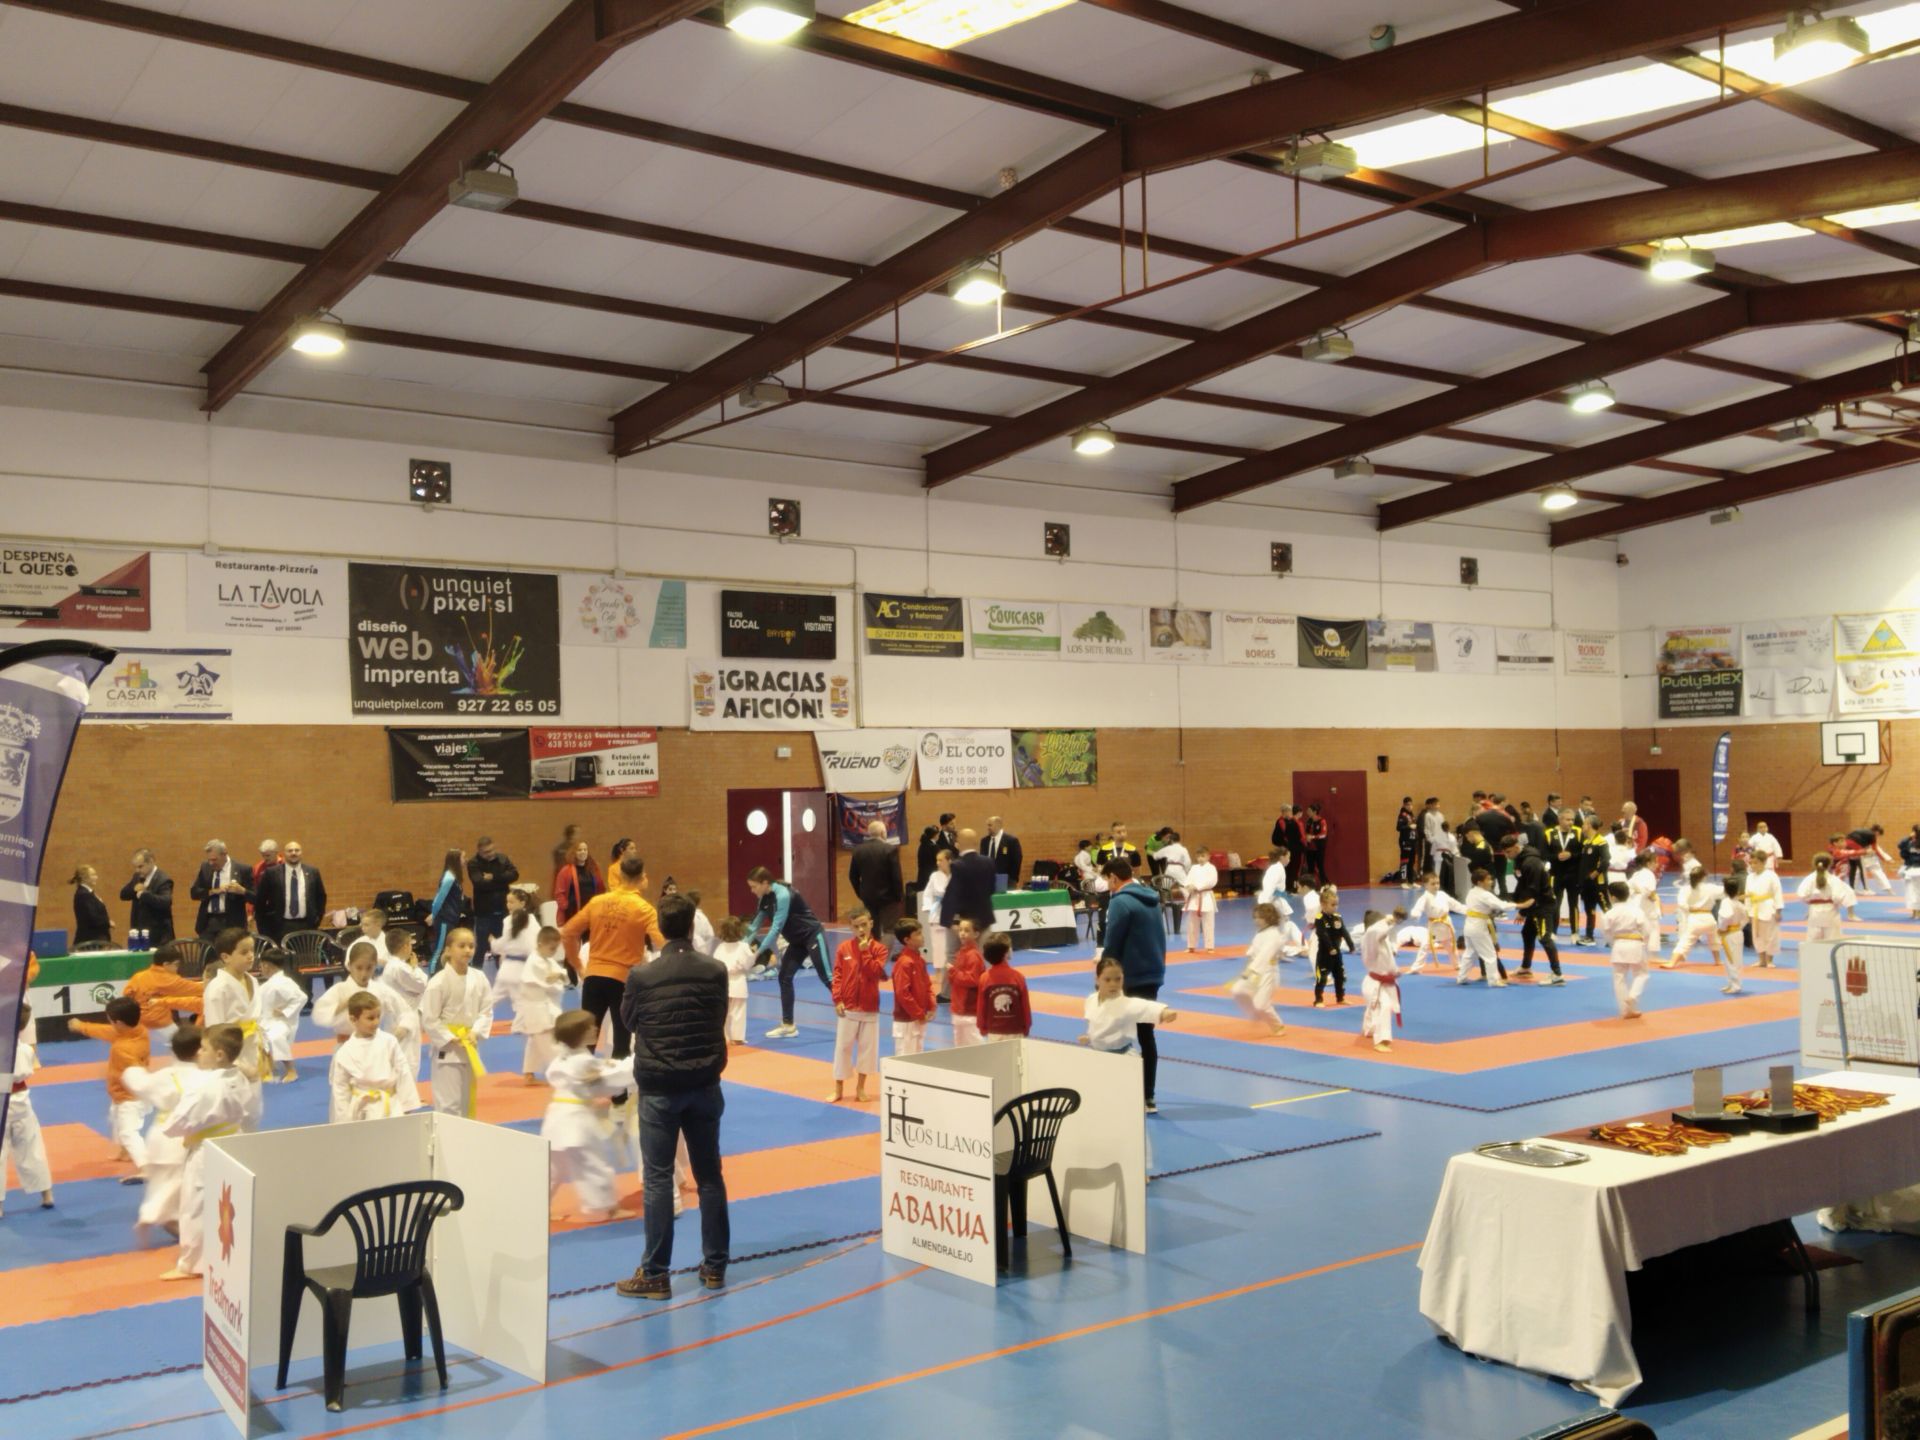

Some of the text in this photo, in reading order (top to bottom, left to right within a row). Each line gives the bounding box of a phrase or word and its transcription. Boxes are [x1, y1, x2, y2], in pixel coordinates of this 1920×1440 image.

[3, 550, 75, 563] DESPENSA
[0, 562, 13, 574] L
[215, 561, 319, 575] Restaurante-Pizzería
[218, 584, 243, 602] LA
[432, 577, 513, 598] unquiet
[984, 605, 1045, 625] COVICASH
[357, 620, 408, 633] diseño
[729, 619, 760, 630] LOCAL
[804, 622, 833, 633] VISITANTE
[357, 631, 433, 662] web
[1067, 645, 1084, 654] LOS
[364, 664, 460, 688] imprenta
[718, 669, 827, 694] ¡GRACIAS
[106, 689, 157, 701] CASAR
[353, 698, 557, 713] unquietpixel.com 927 22 65 05
[722, 692, 825, 719] AFICIÓN!
[434, 742, 468, 757] viajes
[946, 746, 1005, 757] EL COTO
[821, 751, 882, 769] TRUENO
[1008, 910, 1022, 930] 2
[53, 986, 71, 1014] 1
[936, 1131, 991, 1160] LLANOS
[900, 1170, 974, 1202] RESTAURANTE
[889, 1192, 989, 1245] ABAKUA
[911, 1236, 973, 1264] ALMENDRALEJO
